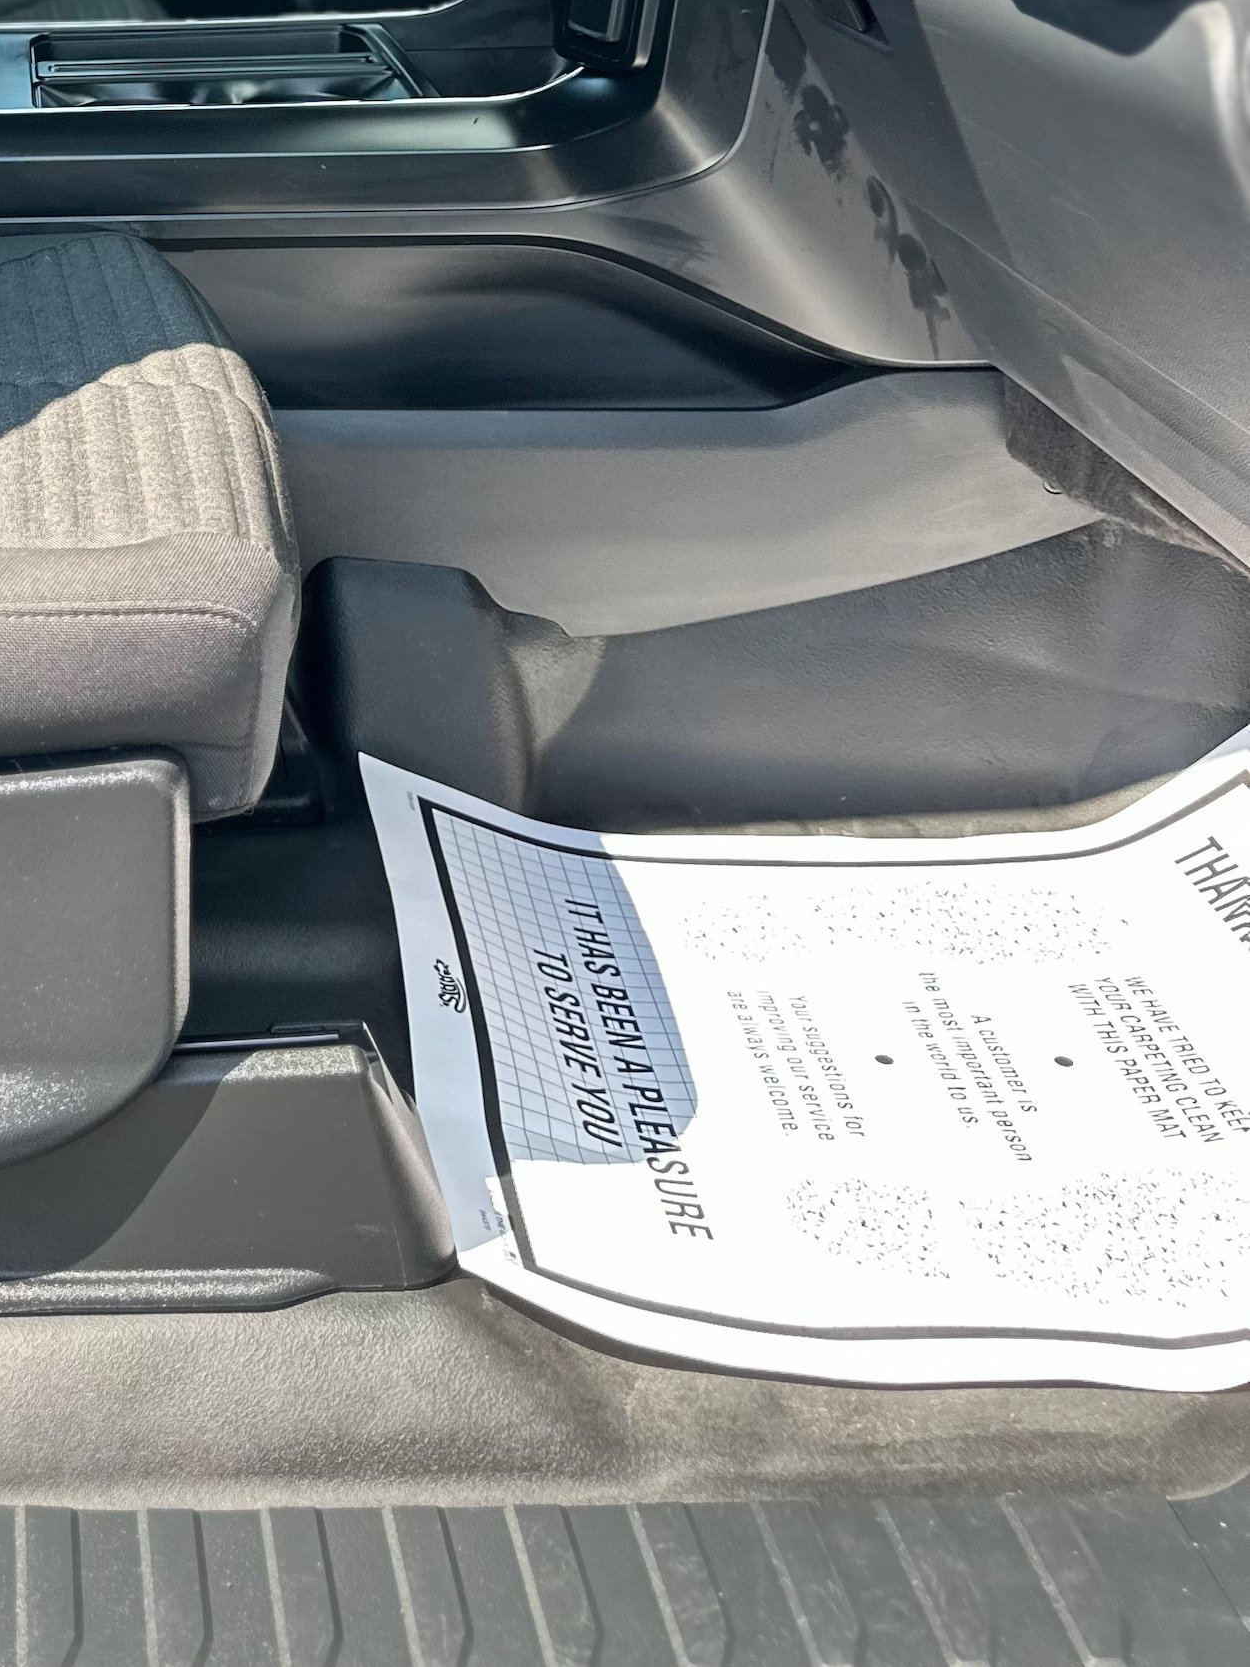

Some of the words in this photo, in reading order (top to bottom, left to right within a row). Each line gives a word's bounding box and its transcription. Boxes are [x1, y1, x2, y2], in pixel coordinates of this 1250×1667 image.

[565, 898, 604, 924] IT
[533, 949, 573, 983] TO
[573, 926, 621, 977] HAS
[591, 983, 647, 1050] BEEN
[727, 990, 748, 1010] are
[902, 1001, 921, 1013] in
[970, 1015, 992, 1024] A
[544, 986, 602, 1079] SERVE
[737, 1015, 770, 1059] always
[911, 1019, 934, 1038] the
[1124, 976, 1153, 996] WE
[1140, 1000, 1180, 1033] HAVE
[1168, 1035, 1210, 1074] TRIED
[1199, 1078, 1227, 1096] TO
[614, 1055, 655, 1073] A
[788, 995, 812, 1022] Your
[802, 1026, 854, 1109] suggestions
[843, 1116, 865, 1137] for
[918, 972, 940, 992] the
[932, 998, 964, 1031] most
[951, 1037, 1004, 1104] important
[986, 1110, 1032, 1161] person
[925, 1043, 962, 1080] world
[979, 1030, 1027, 1094] customer
[1068, 984, 1106, 1016] WITH
[1093, 1021, 1129, 1054] THIS
[1114, 1058, 1161, 1104] PAPER
[1147, 1108, 1187, 1138] MAT
[1094, 977, 1132, 1010] YOUR
[1120, 1015, 1188, 1092] CARPETING
[1175, 1096, 1224, 1143] CLEAN
[571, 1083, 623, 1148] YOU
[786, 1057, 809, 1079] our
[799, 1085, 835, 1140] service
[948, 1086, 967, 1100] to
[1018, 1099, 1038, 1112] is
[622, 1083, 714, 1240] PLEASURE
